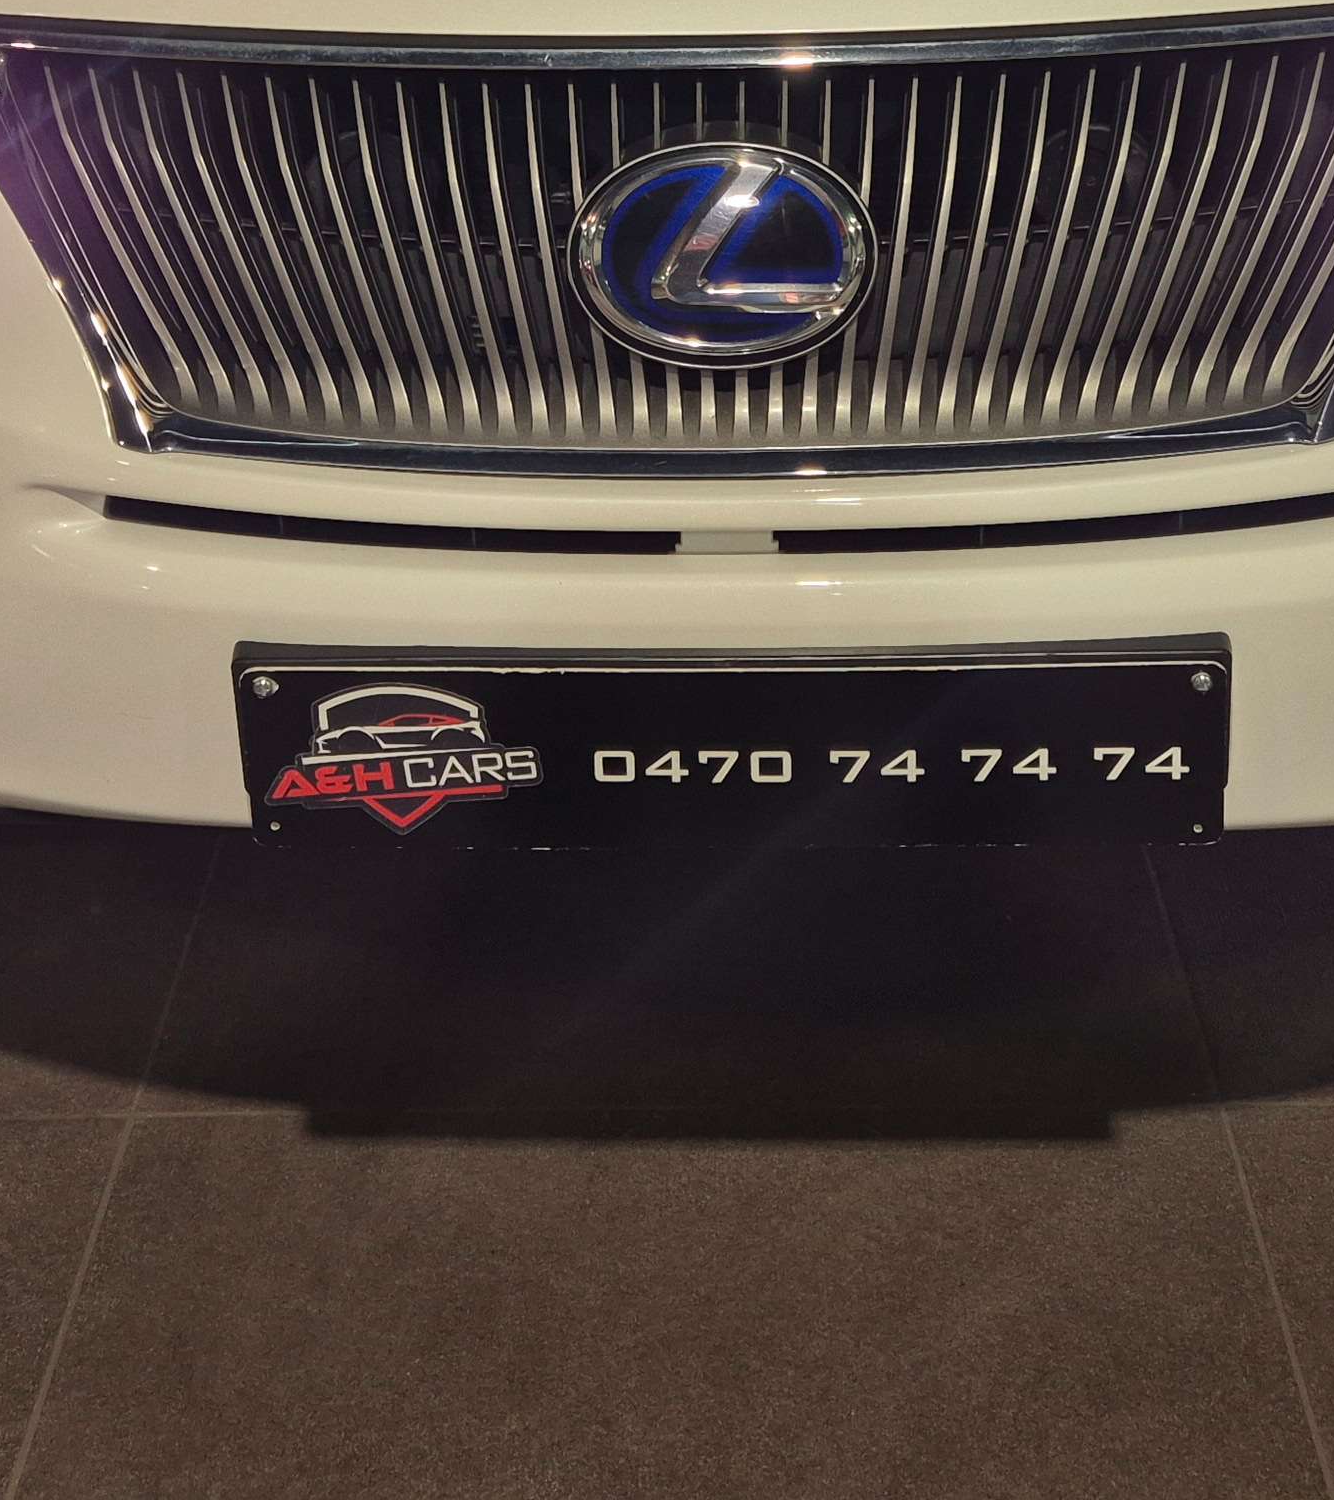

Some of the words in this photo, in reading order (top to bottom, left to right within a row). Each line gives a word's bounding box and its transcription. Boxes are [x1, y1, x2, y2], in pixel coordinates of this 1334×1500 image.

[272, 761, 395, 799] A&H
[403, 750, 537, 788] CARS
[593, 749, 792, 783] 0470
[829, 749, 925, 783] 74
[961, 748, 1057, 782] 74
[1093, 746, 1190, 781] 74
